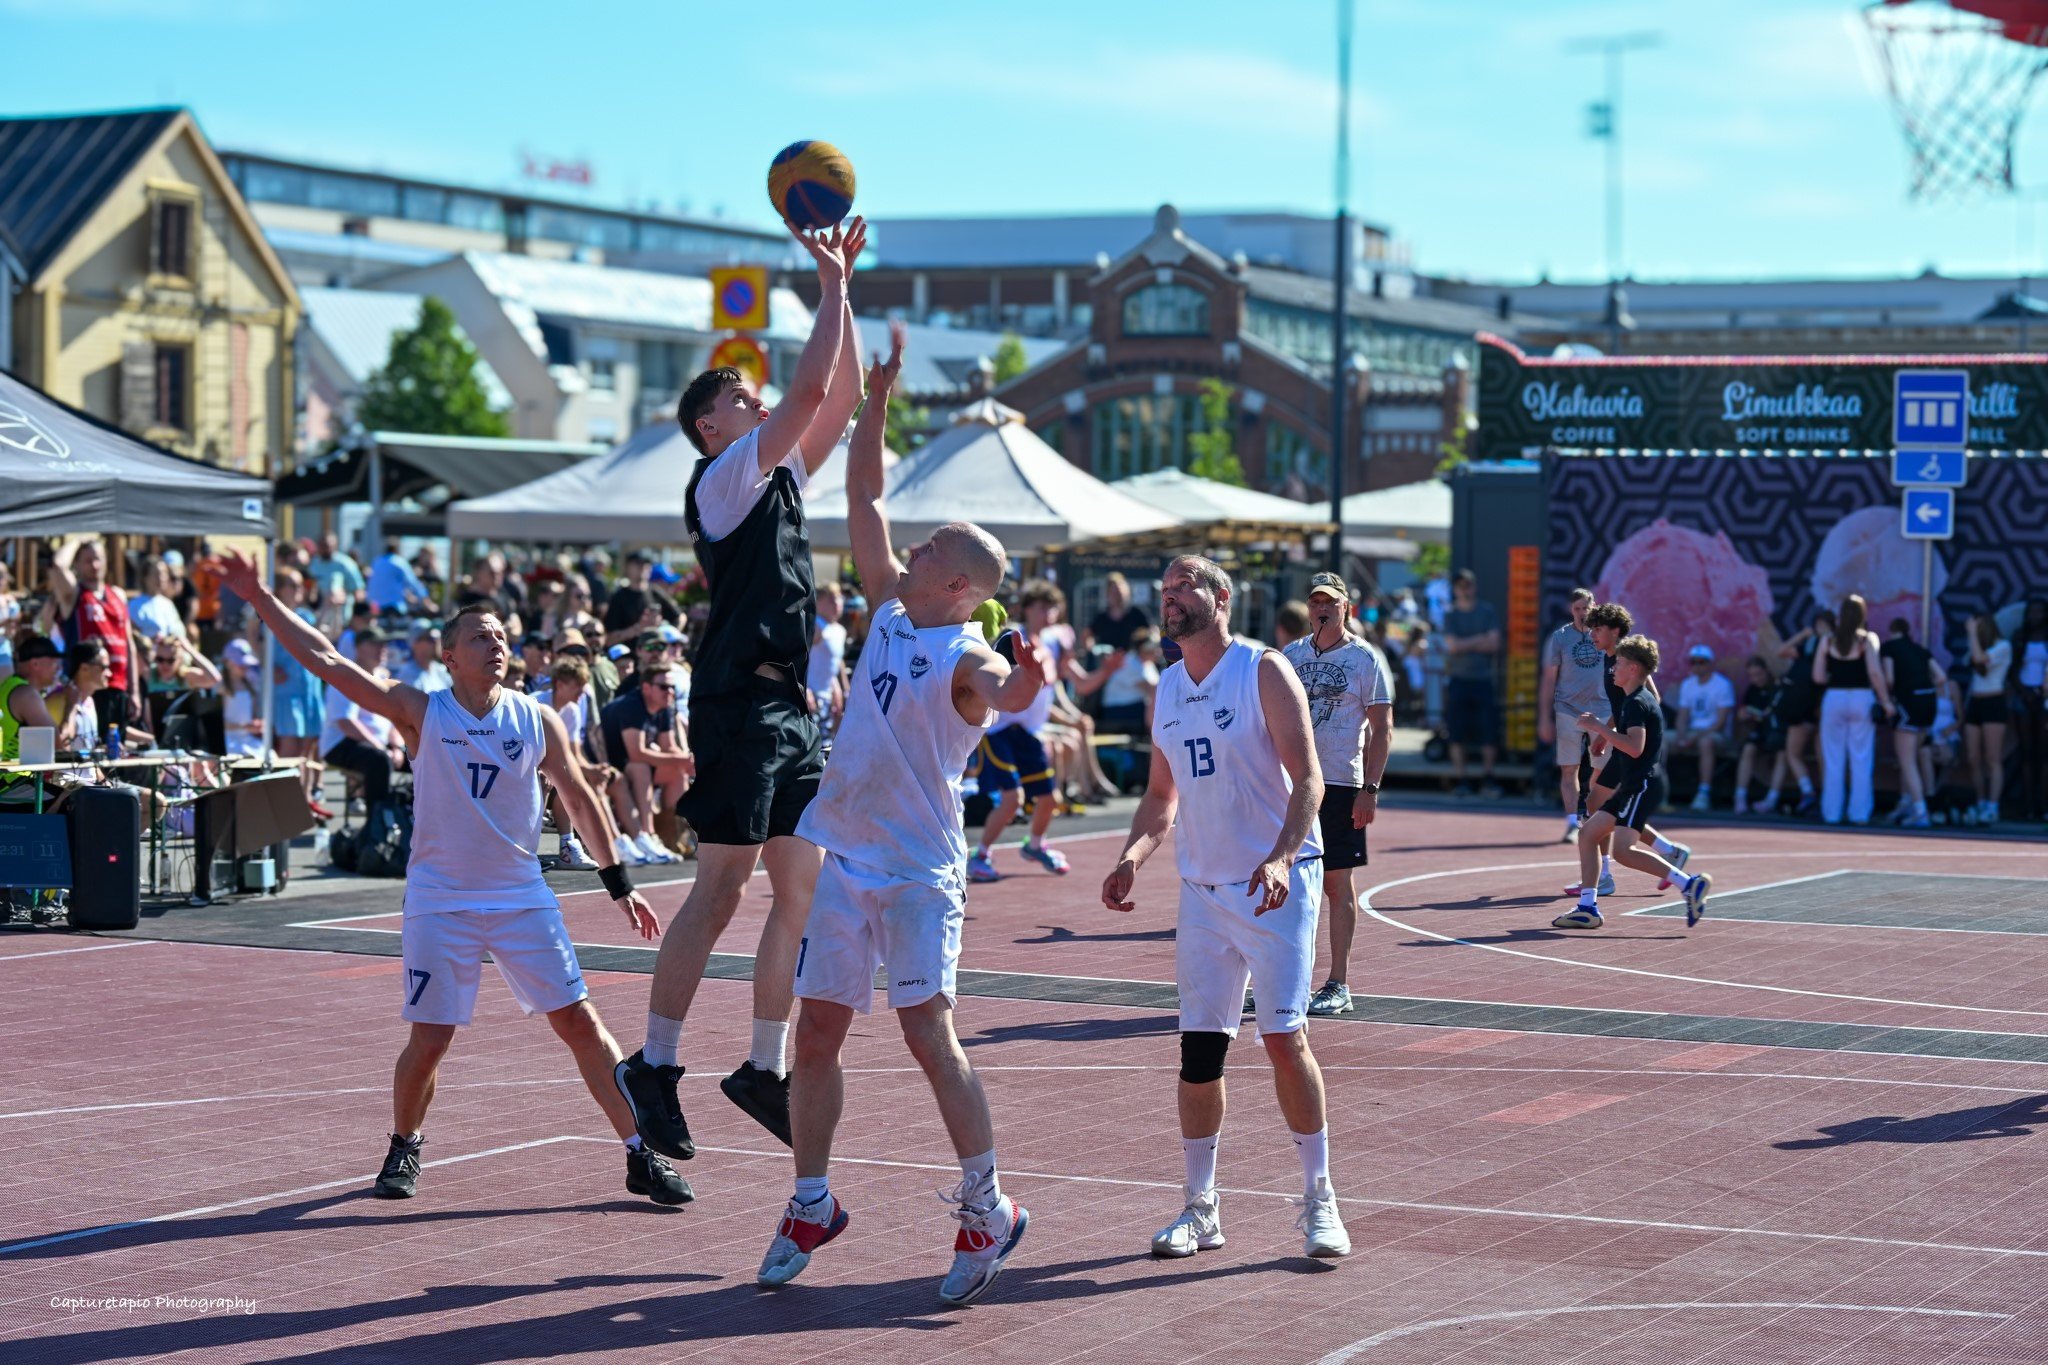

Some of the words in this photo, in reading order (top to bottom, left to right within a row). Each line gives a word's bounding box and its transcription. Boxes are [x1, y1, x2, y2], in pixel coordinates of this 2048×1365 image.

[1522, 381, 1644, 421] Kahavia
[1721, 381, 1863, 421] Limukkaa
[1967, 382, 2020, 418] rilli
[1552, 426, 1616, 443] COFFEE
[1735, 427, 1779, 444] SOFT
[1784, 427, 1850, 444] DRINKS
[1969, 427, 2007, 444] RILL
[466, 728, 495, 736] stadium
[441, 737, 463, 746] CRAFT
[1184, 737, 1216, 777] 13
[467, 762, 500, 799] 17
[897, 979, 921, 987] CRAFT
